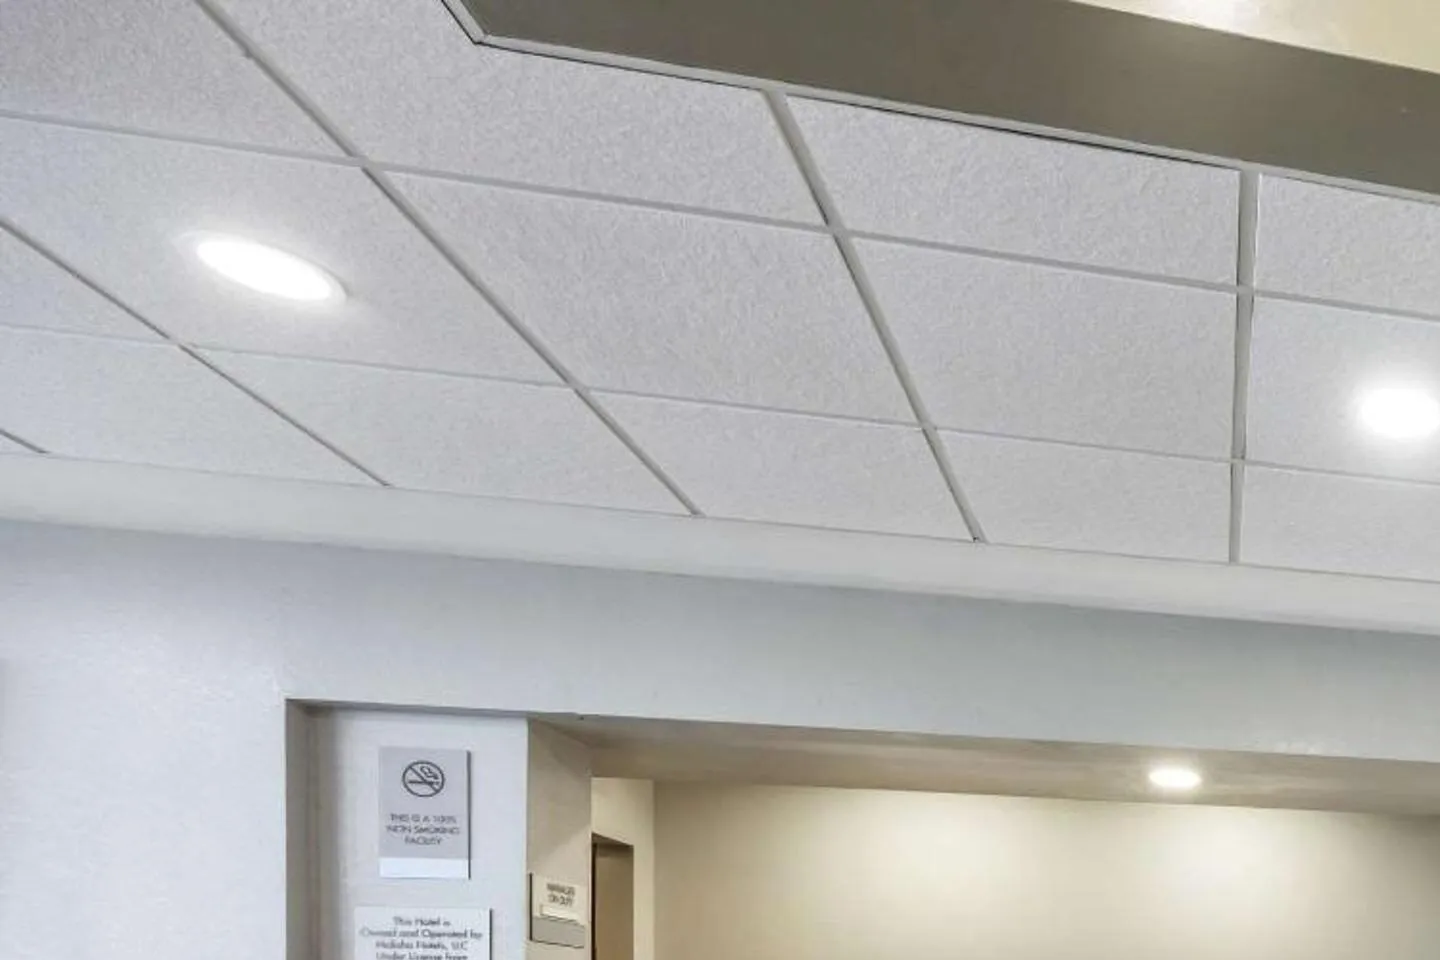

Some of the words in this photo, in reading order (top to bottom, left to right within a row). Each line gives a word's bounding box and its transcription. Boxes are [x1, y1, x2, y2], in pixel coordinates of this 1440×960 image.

[414, 825, 460, 835] SMOKING
[415, 916, 441, 926] Hotel
[399, 929, 419, 938] and
[421, 928, 467, 940] Operated
